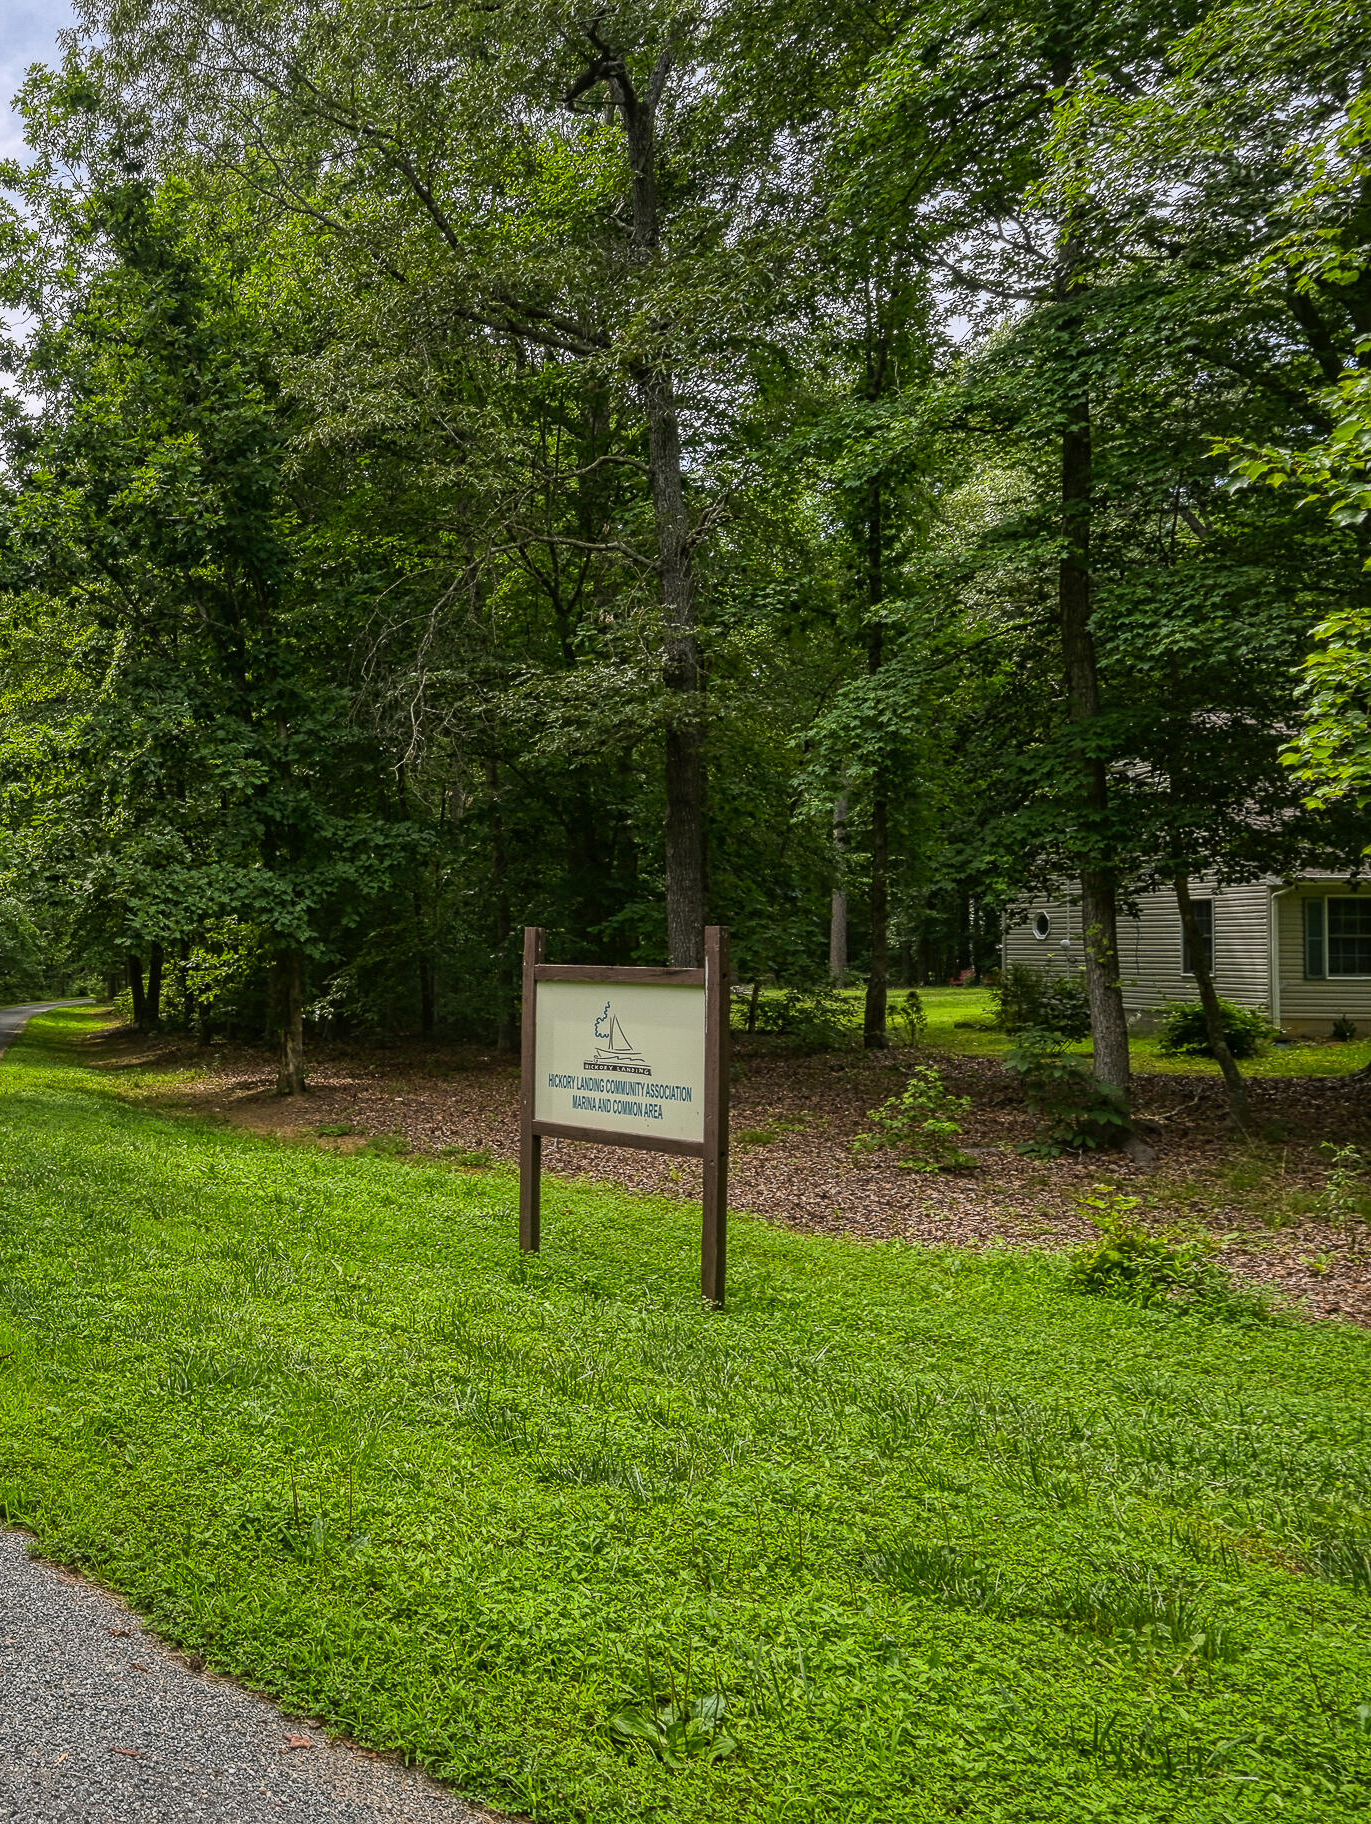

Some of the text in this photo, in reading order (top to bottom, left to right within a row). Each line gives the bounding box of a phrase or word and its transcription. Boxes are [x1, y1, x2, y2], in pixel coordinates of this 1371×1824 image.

[616, 1066, 650, 1075] LANDING
[548, 1073, 692, 1102] HICKORY LANDING COMMUNITY ASSOCIATION
[572, 1095, 663, 1119] MARINA AND COMMON AREA
